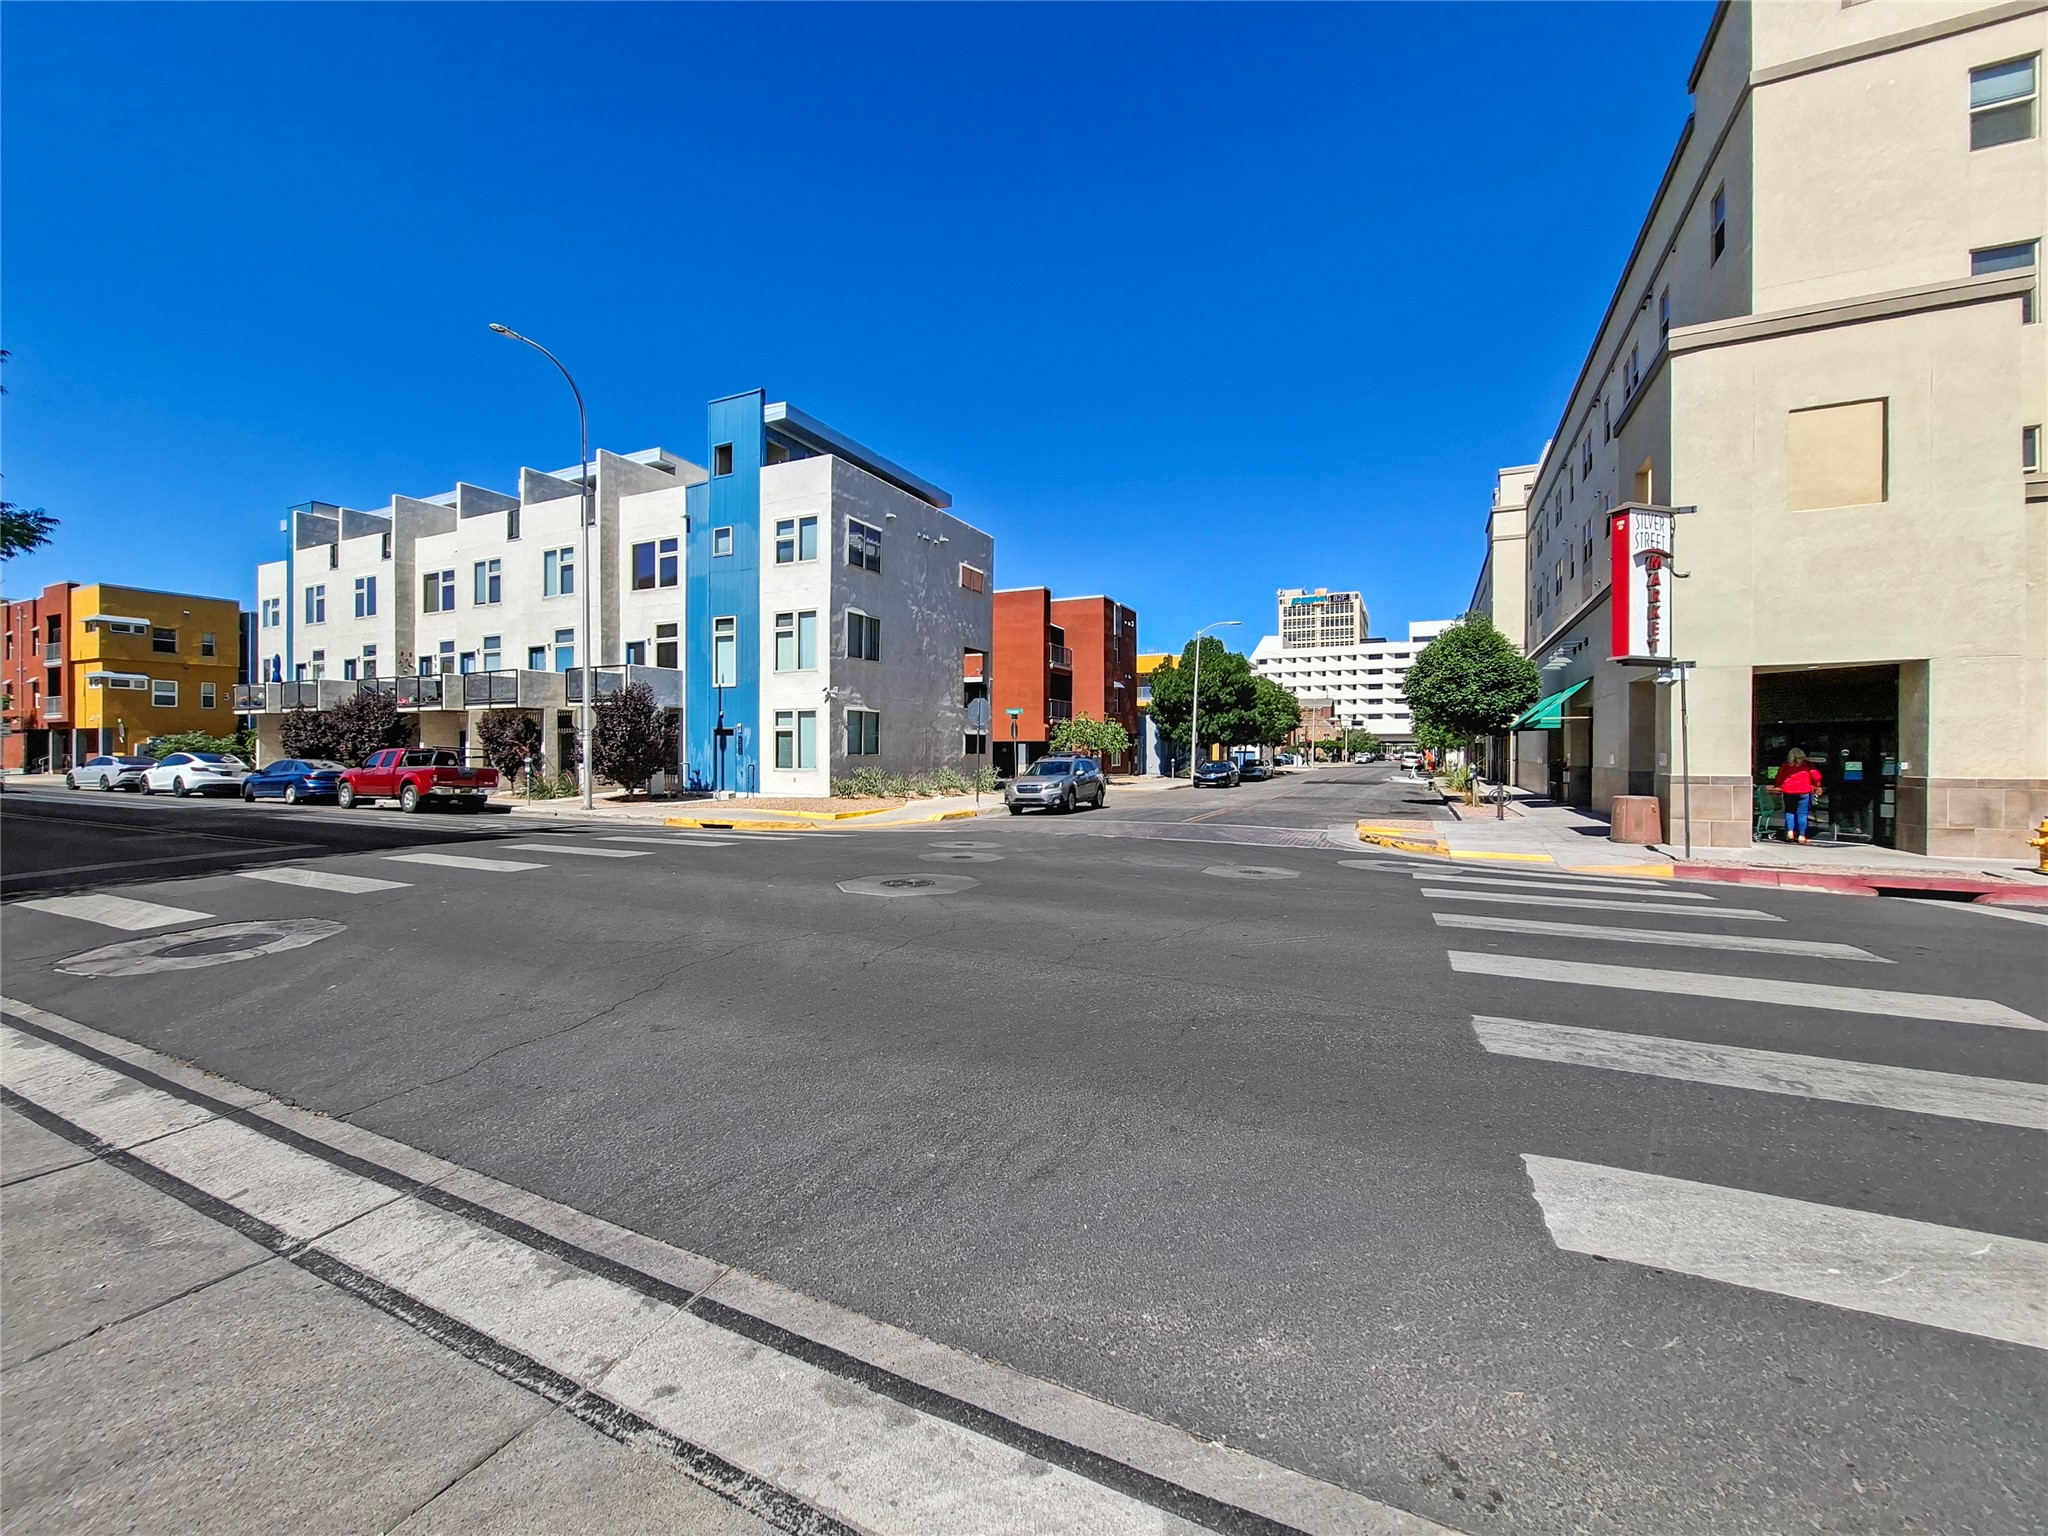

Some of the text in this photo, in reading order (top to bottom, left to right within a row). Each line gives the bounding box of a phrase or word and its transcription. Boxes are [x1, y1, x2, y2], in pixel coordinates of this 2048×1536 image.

[1635, 512, 1665, 533] SILVER
[1635, 531, 1665, 550] STREET
[1646, 554, 1662, 655] MARKET
[223, 692, 230, 701] 3
